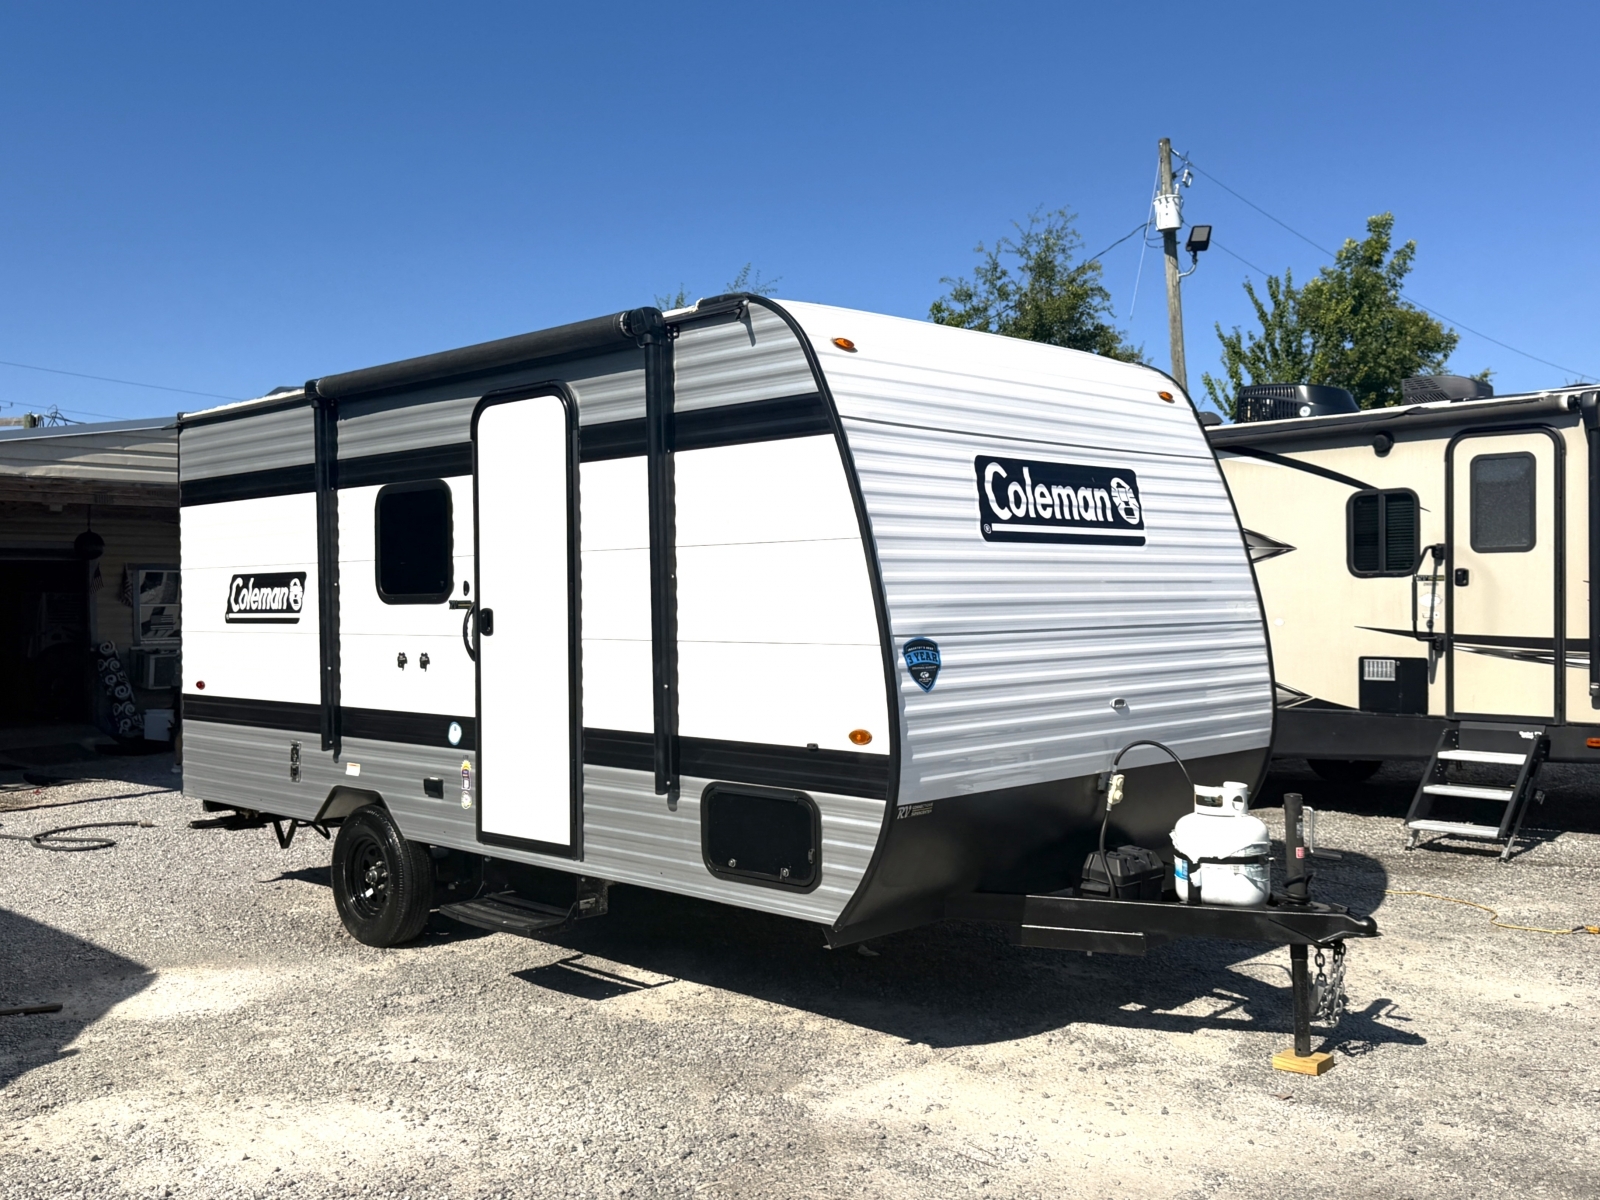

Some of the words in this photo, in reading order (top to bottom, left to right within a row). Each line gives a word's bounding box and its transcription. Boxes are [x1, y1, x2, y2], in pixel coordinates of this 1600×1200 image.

[984, 462, 1114, 522] Coleman
[230, 577, 289, 612] Coleman
[907, 655, 914, 664] 3
[914, 652, 938, 662] YEAR
[897, 805, 912, 820] RV
